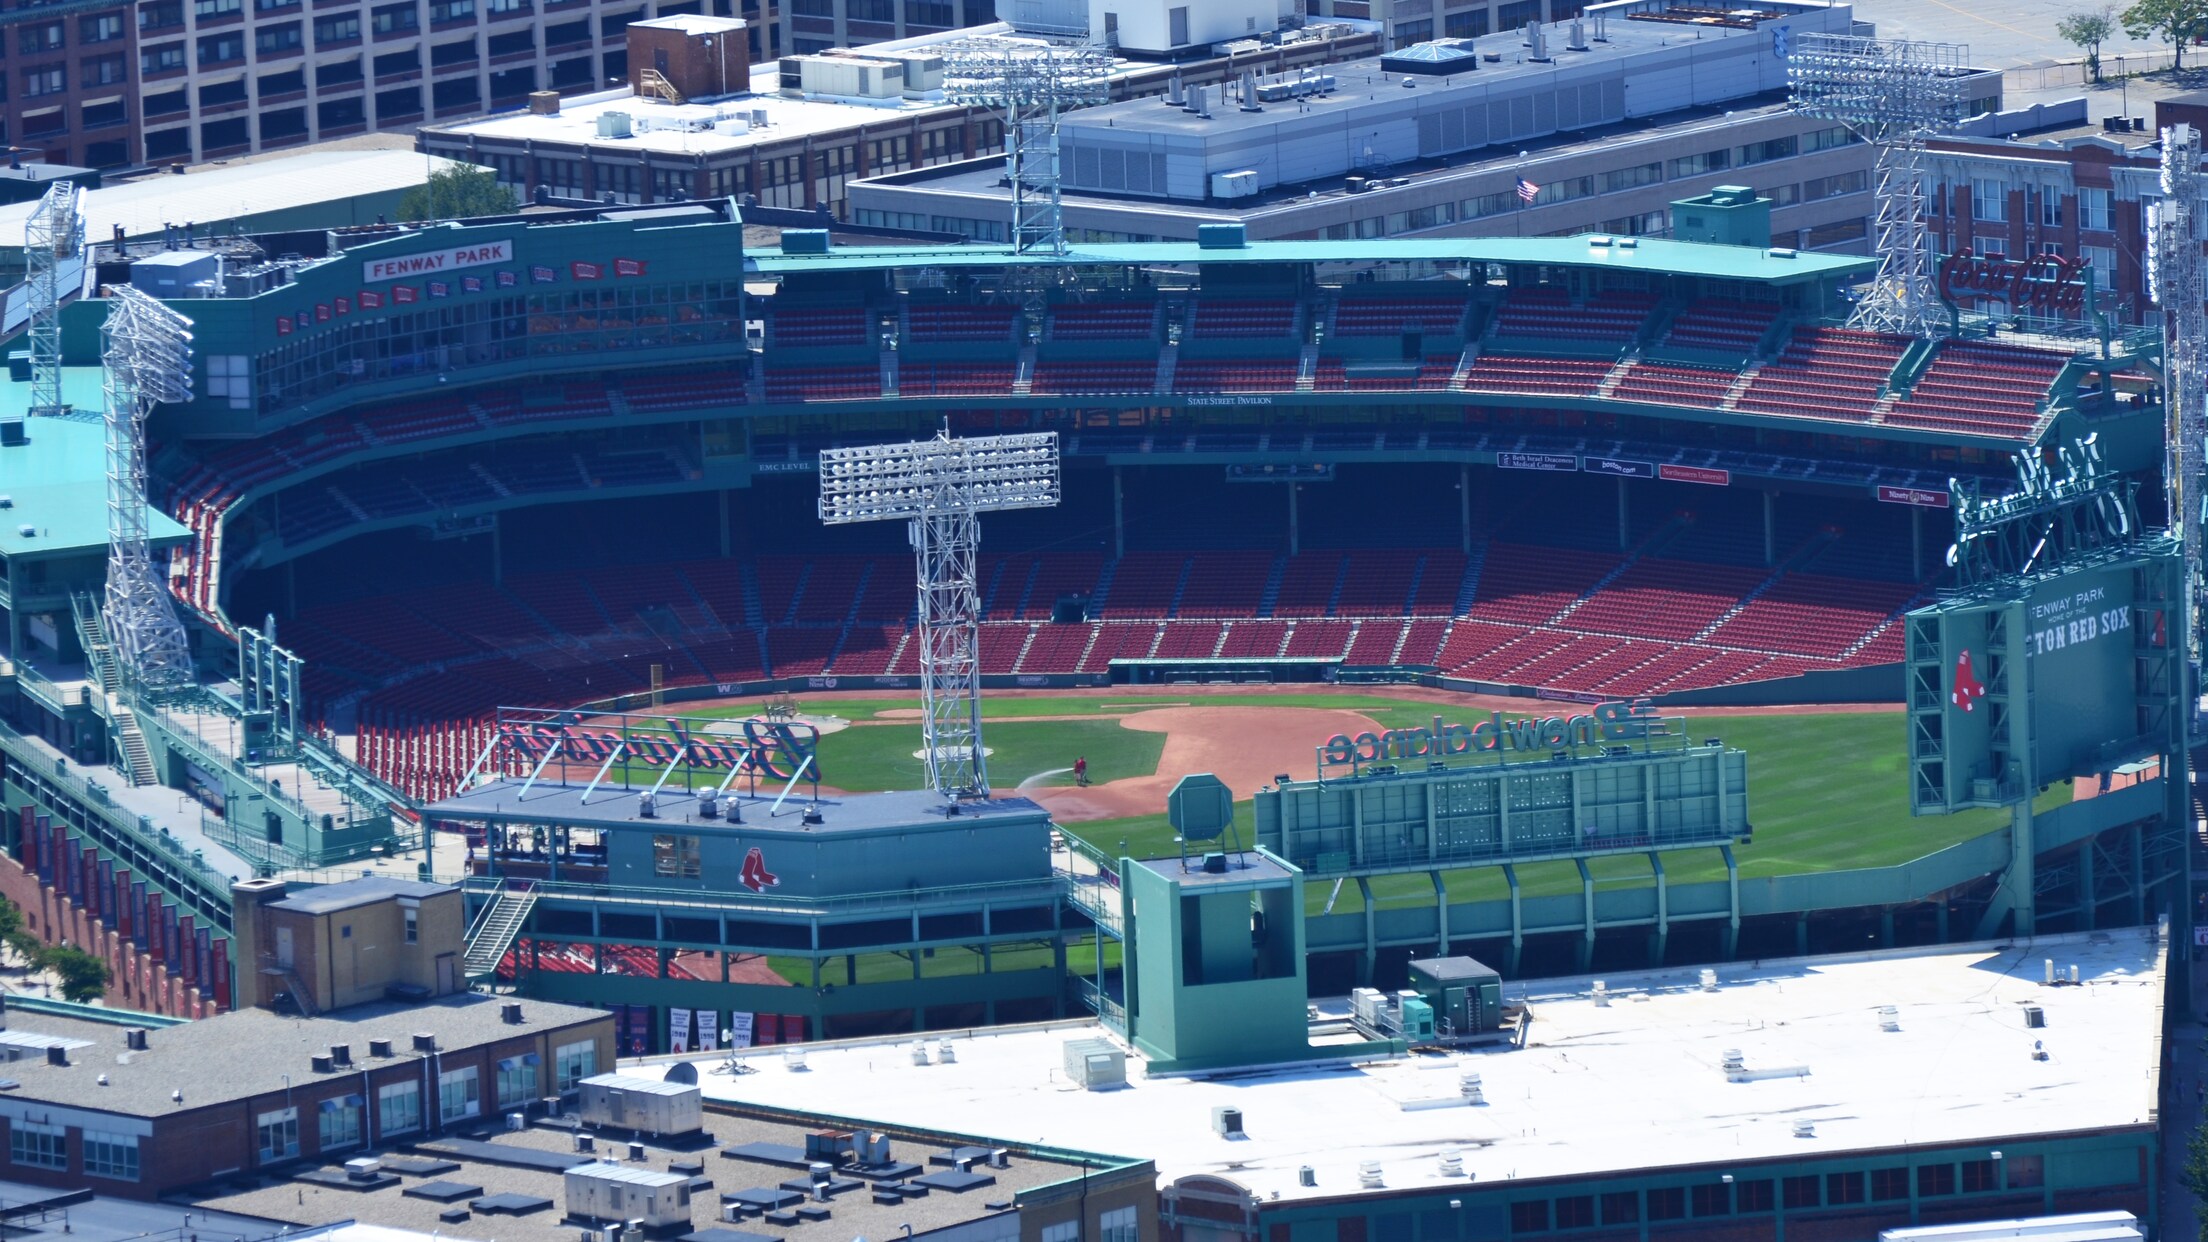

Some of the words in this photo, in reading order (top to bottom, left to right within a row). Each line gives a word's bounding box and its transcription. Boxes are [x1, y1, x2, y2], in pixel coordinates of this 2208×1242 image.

[373, 254, 445, 277] FENWAY
[456, 245, 503, 265] PARK
[1188, 397, 1209, 405] STATE
[1210, 397, 1236, 405] STREET
[1237, 396, 1272, 405] PAVILION
[759, 463, 779, 471] EMC
[2076, 587, 2105, 606] PARK
[2069, 616, 2097, 645] RED
[2101, 605, 2131, 635] SOX
